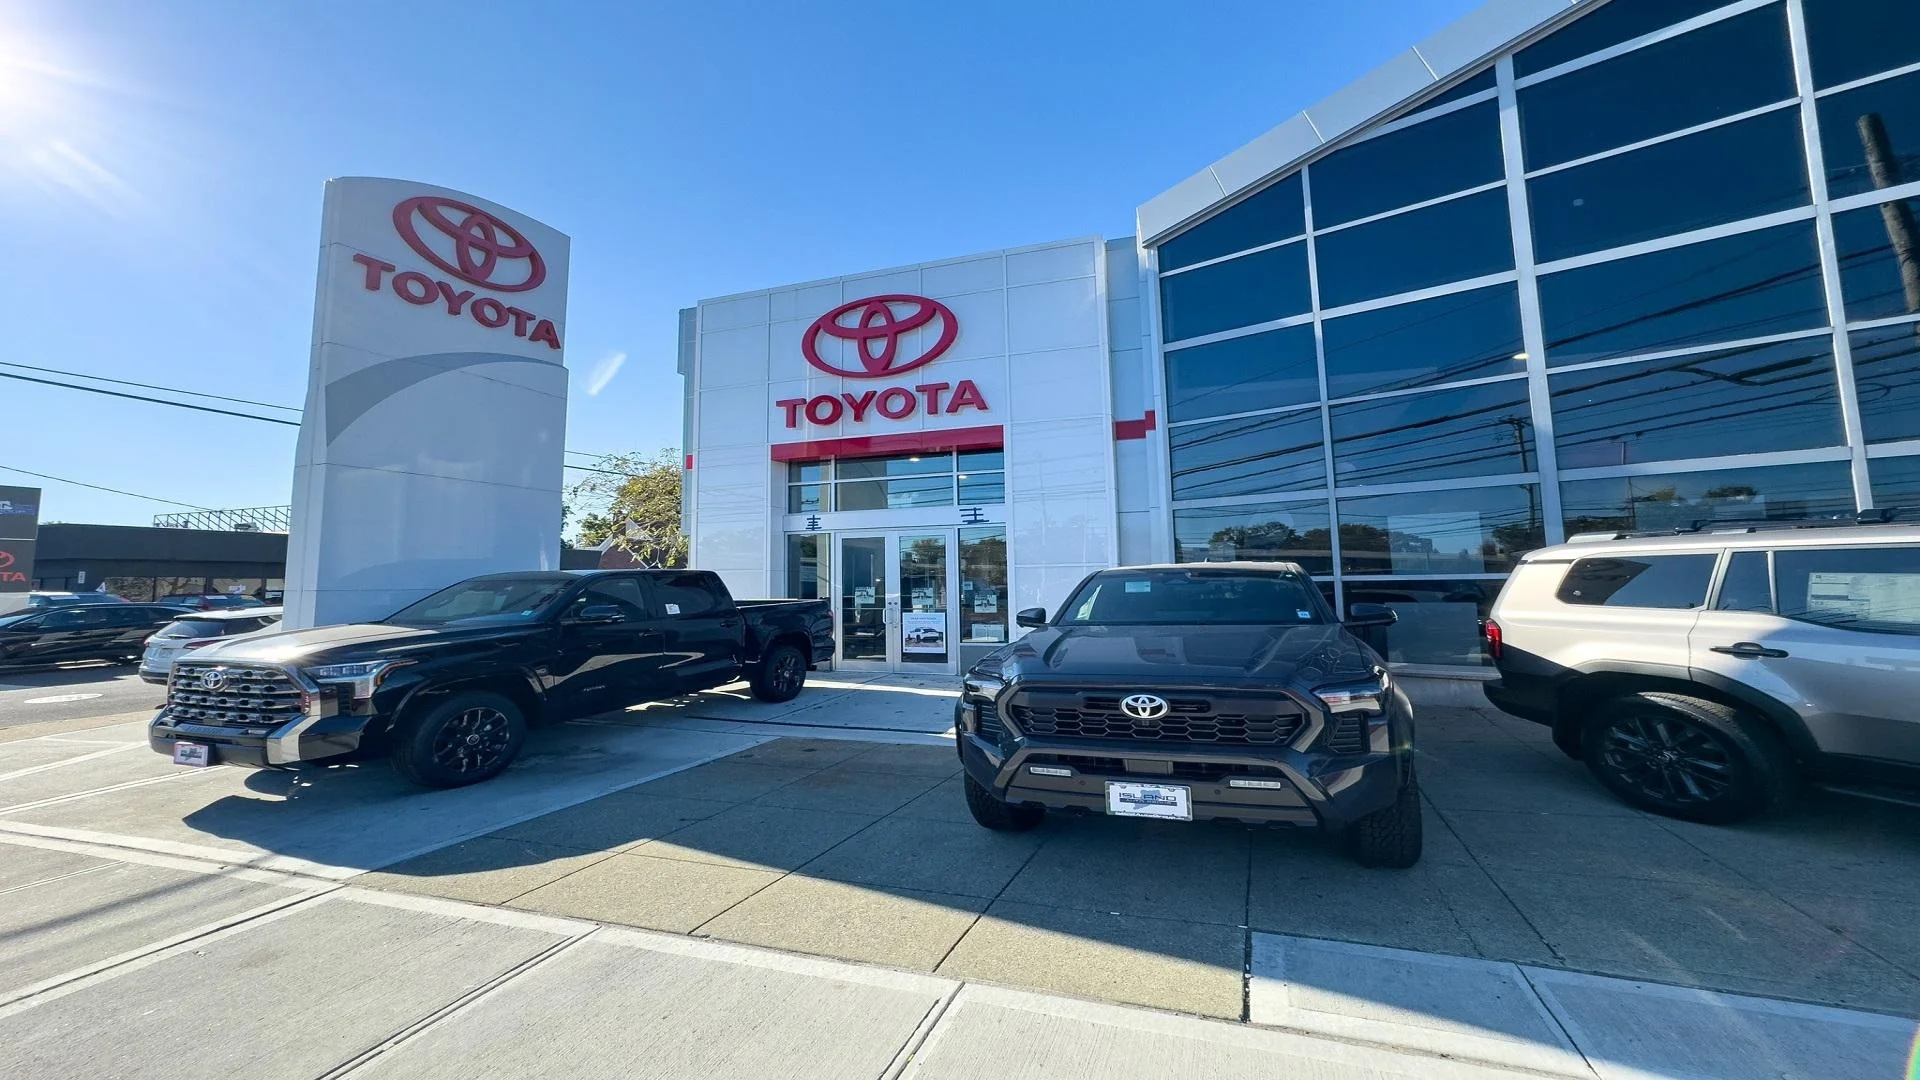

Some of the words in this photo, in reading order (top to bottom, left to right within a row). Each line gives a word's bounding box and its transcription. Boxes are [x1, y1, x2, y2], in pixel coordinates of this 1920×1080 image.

[353, 254, 561, 349] TOYOTA
[776, 380, 988, 429] TOYOTA
[1118, 792, 1177, 802] ISLAND
